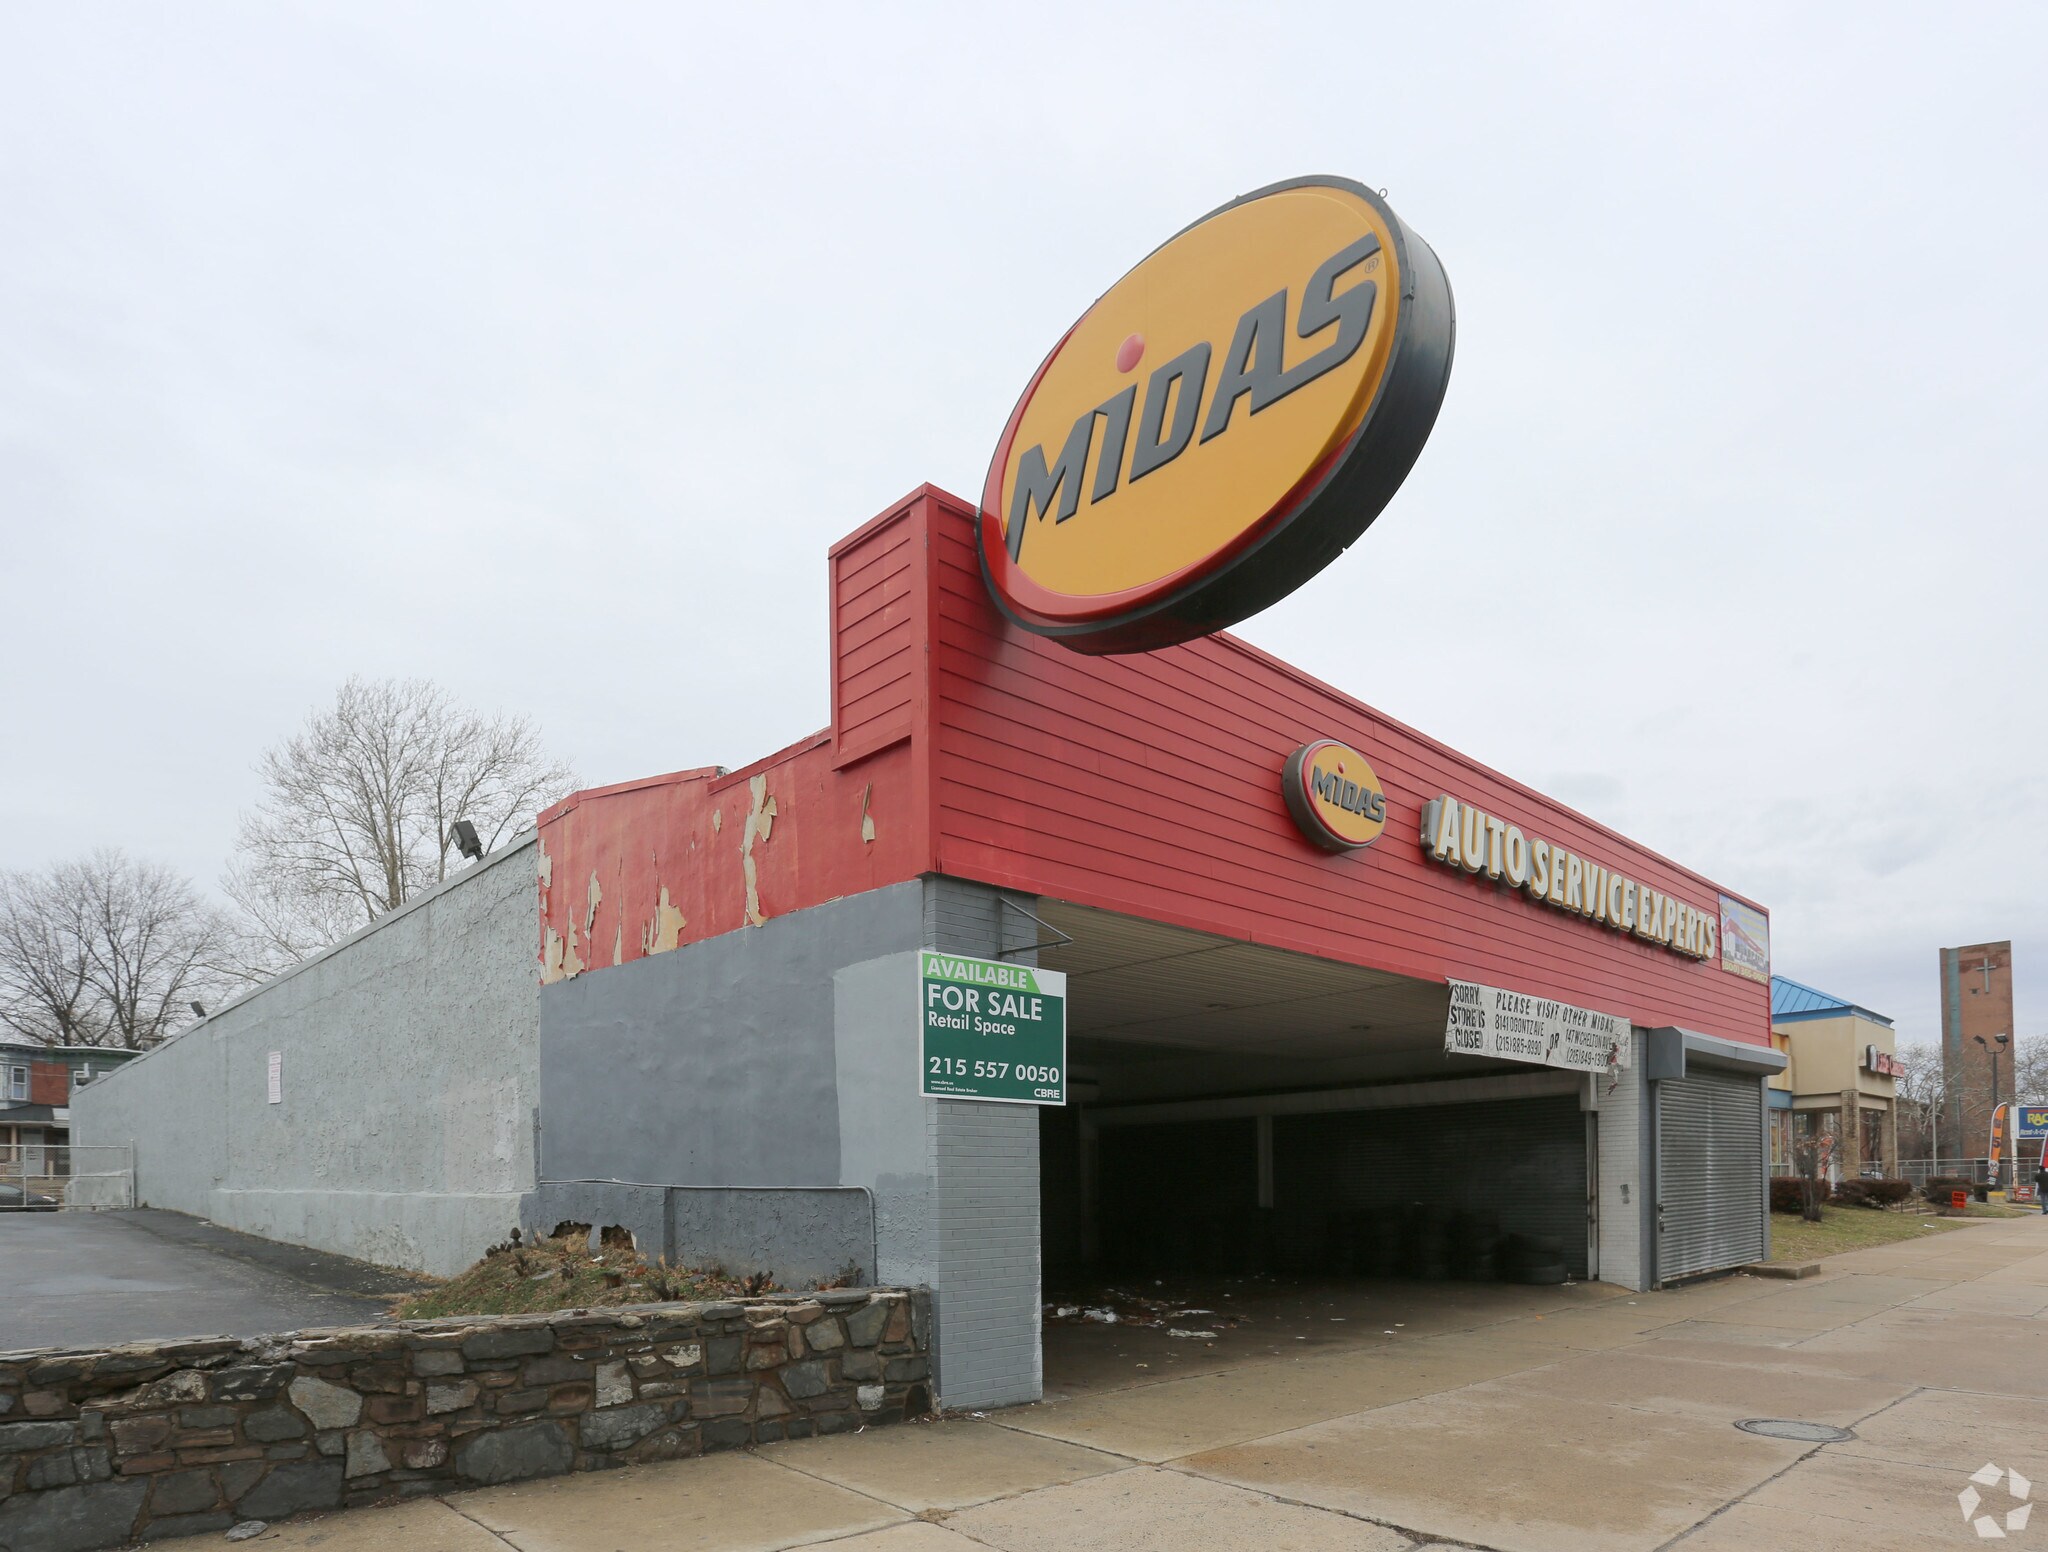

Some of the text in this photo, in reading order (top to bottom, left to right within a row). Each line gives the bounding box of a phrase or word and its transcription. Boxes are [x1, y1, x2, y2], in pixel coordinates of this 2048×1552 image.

[1005, 231, 1381, 564] MIDAS
[1311, 762, 1386, 823] MIDAS
[1434, 795, 1527, 887] AUTO
[1530, 838, 1635, 931] SERVICE
[1636, 886, 1716, 960] EXPERTS
[927, 958, 1027, 989] AVAILABLE
[928, 984, 1042, 1021] FOR SALE
[1450, 1005, 1485, 1028] STORE IS
[1496, 992, 1615, 1033] PLEASE VISIT OTHER MIDAS
[928, 1011, 1016, 1036] Retail Space
[1455, 1028, 1483, 1049] CLOSED
[1550, 1033, 1559, 1049] OR
[929, 1056, 1060, 1084] 215 557 0050
[1034, 1088, 1060, 1099] CBRE
